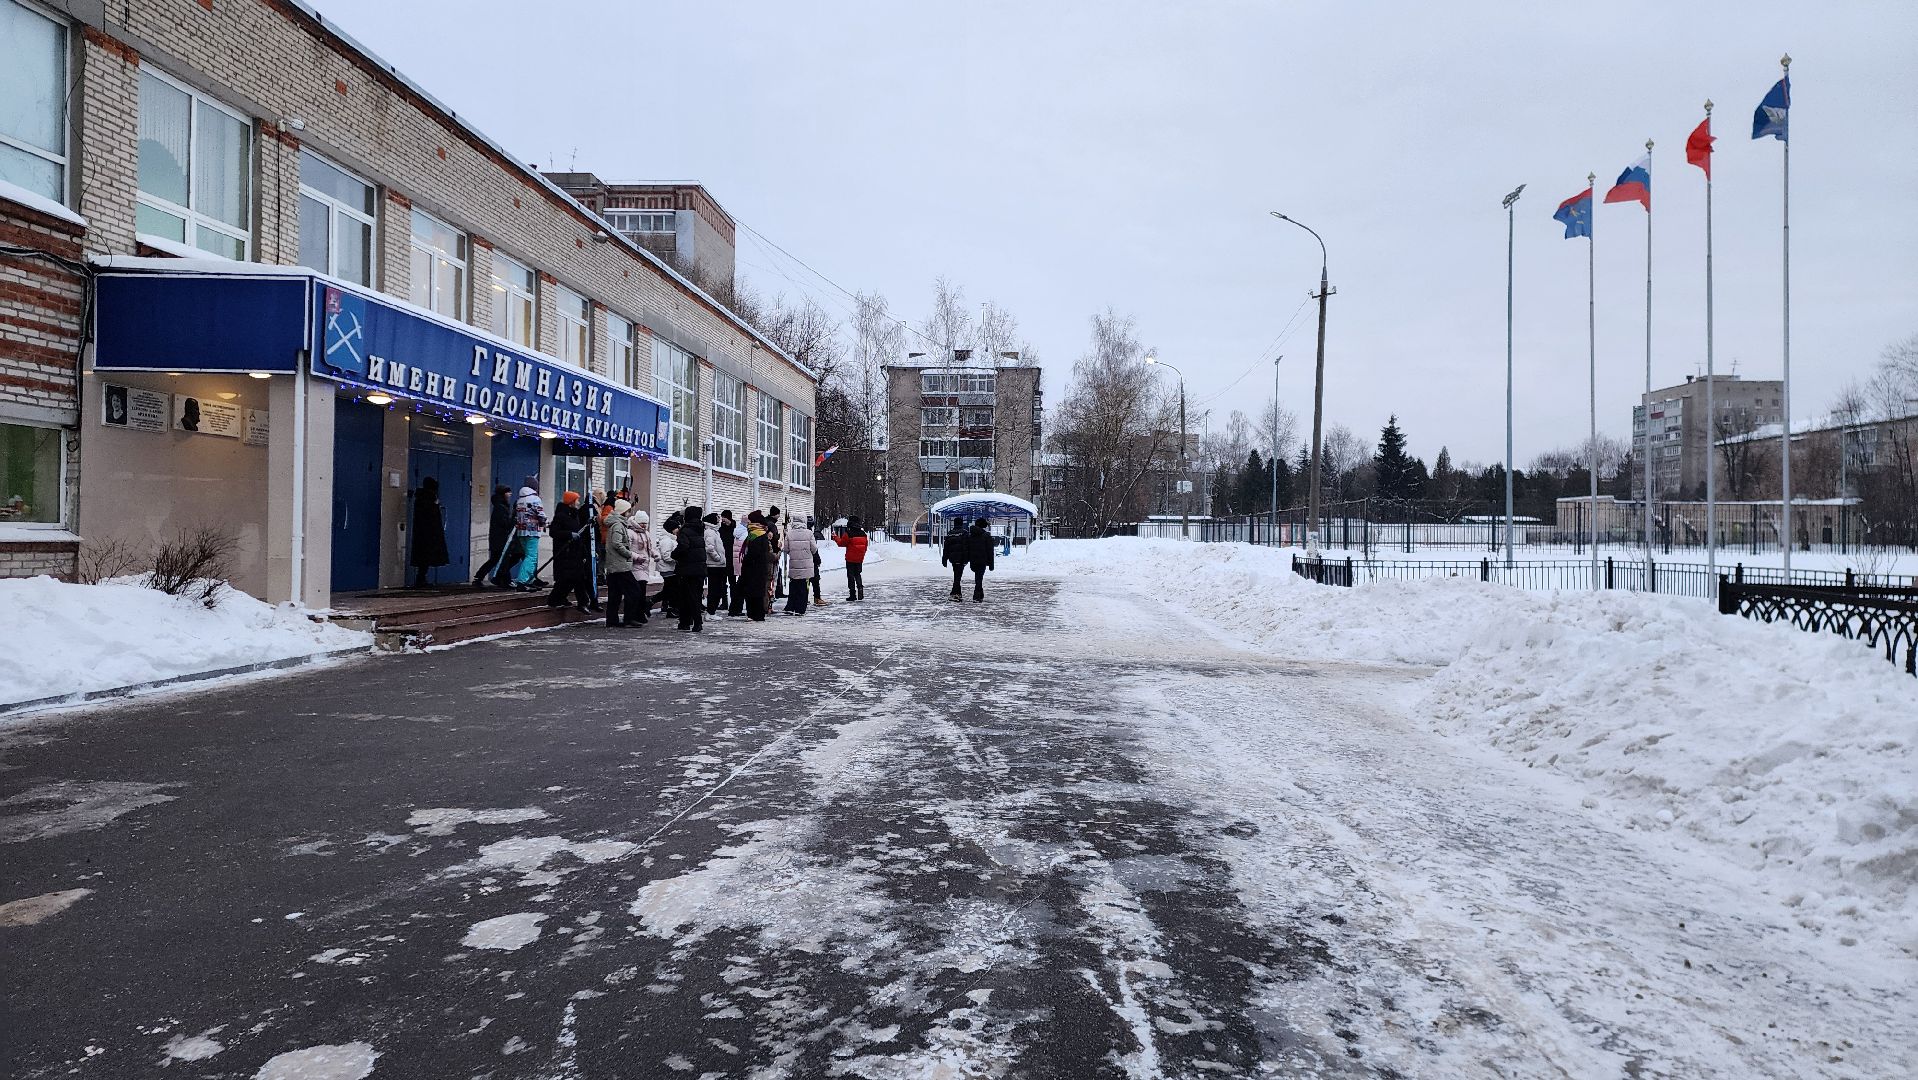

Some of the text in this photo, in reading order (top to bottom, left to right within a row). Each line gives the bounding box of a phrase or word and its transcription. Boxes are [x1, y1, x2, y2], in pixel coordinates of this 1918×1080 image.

[367, 354, 656, 449] ИМЕНИ ПОДОЛЬСКИХ КУРСАНТОВ
[472, 345, 613, 415] ГИМНАЗИЯ
